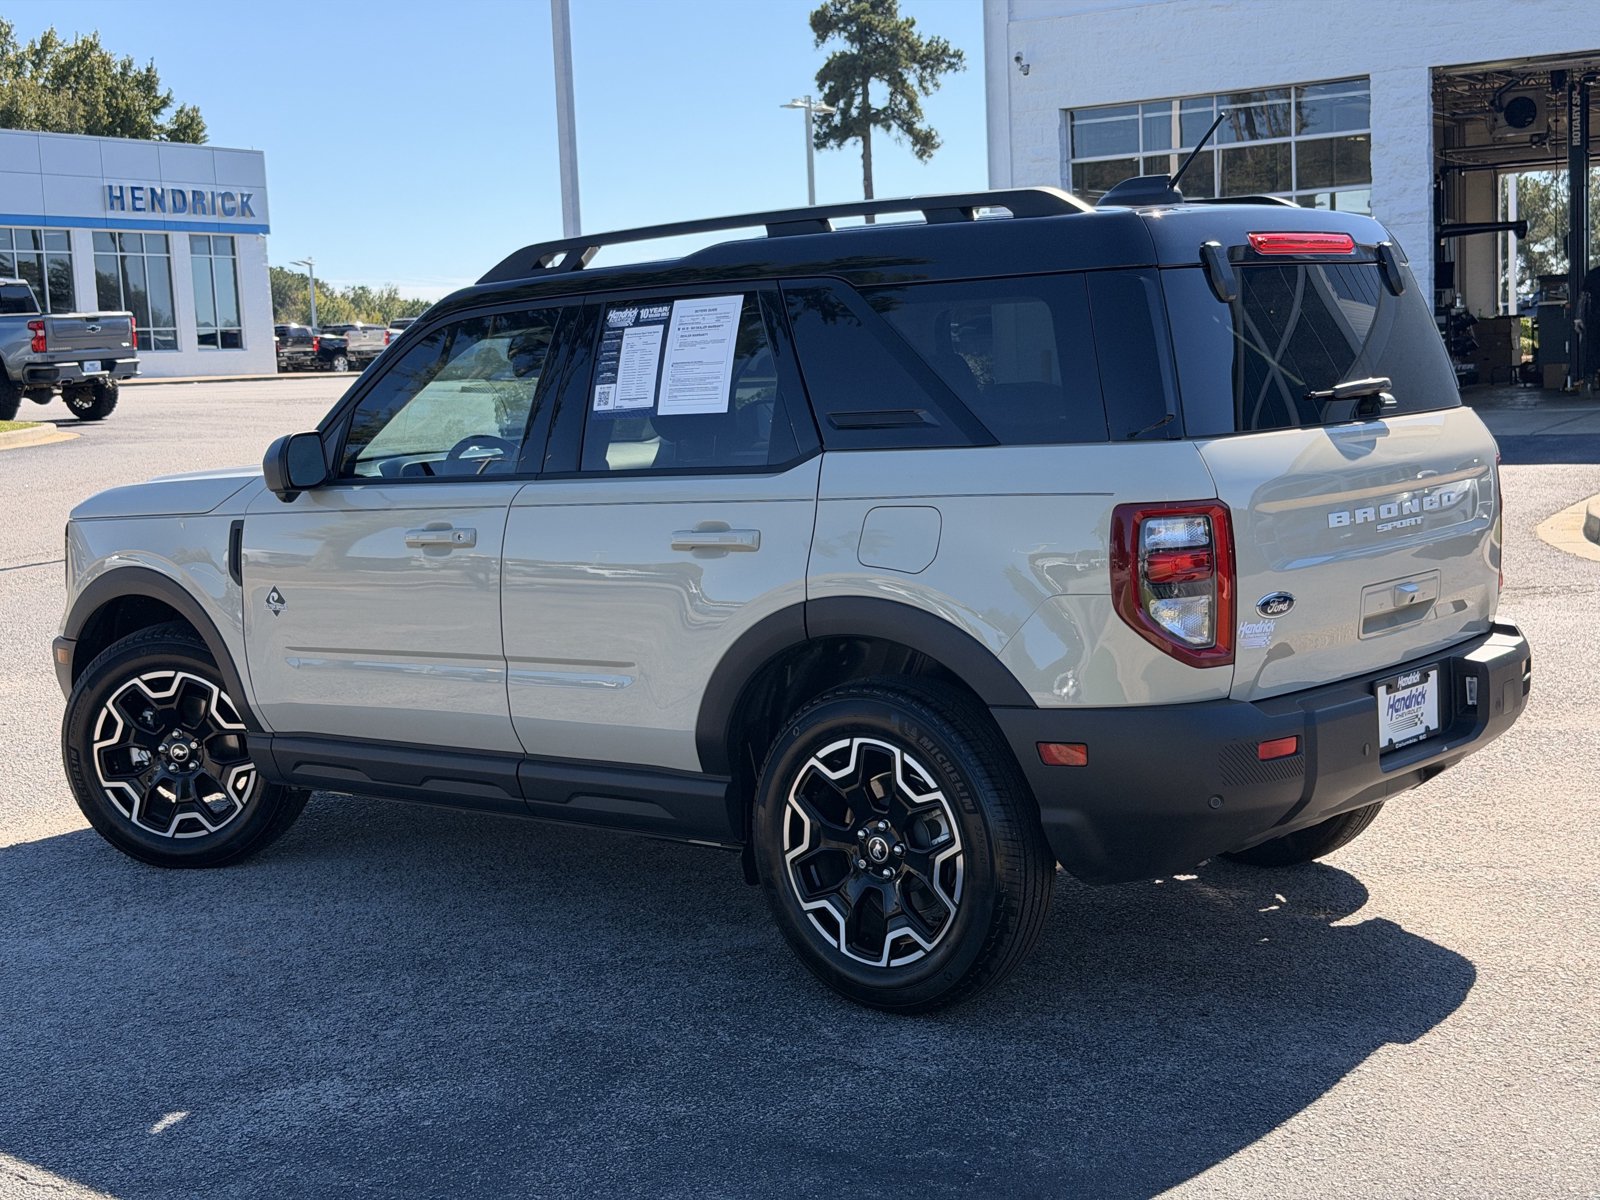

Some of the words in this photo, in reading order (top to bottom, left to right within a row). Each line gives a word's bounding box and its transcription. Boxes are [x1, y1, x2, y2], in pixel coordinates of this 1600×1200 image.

[1572, 106, 1581, 146] ROTARY
[106, 184, 256, 218] HENDRICK
[639, 308, 649, 320] 10
[1327, 491, 1456, 529] BRONCO
[1376, 516, 1424, 533] SPORT
[1267, 598, 1289, 614] Ford
[1238, 620, 1276, 638] Hendrick
[1397, 671, 1421, 690] Hendrick
[1386, 686, 1427, 721] Hendrick
[1395, 707, 1422, 720] CHEVROLET
[918, 737, 978, 814] MICHELIN
